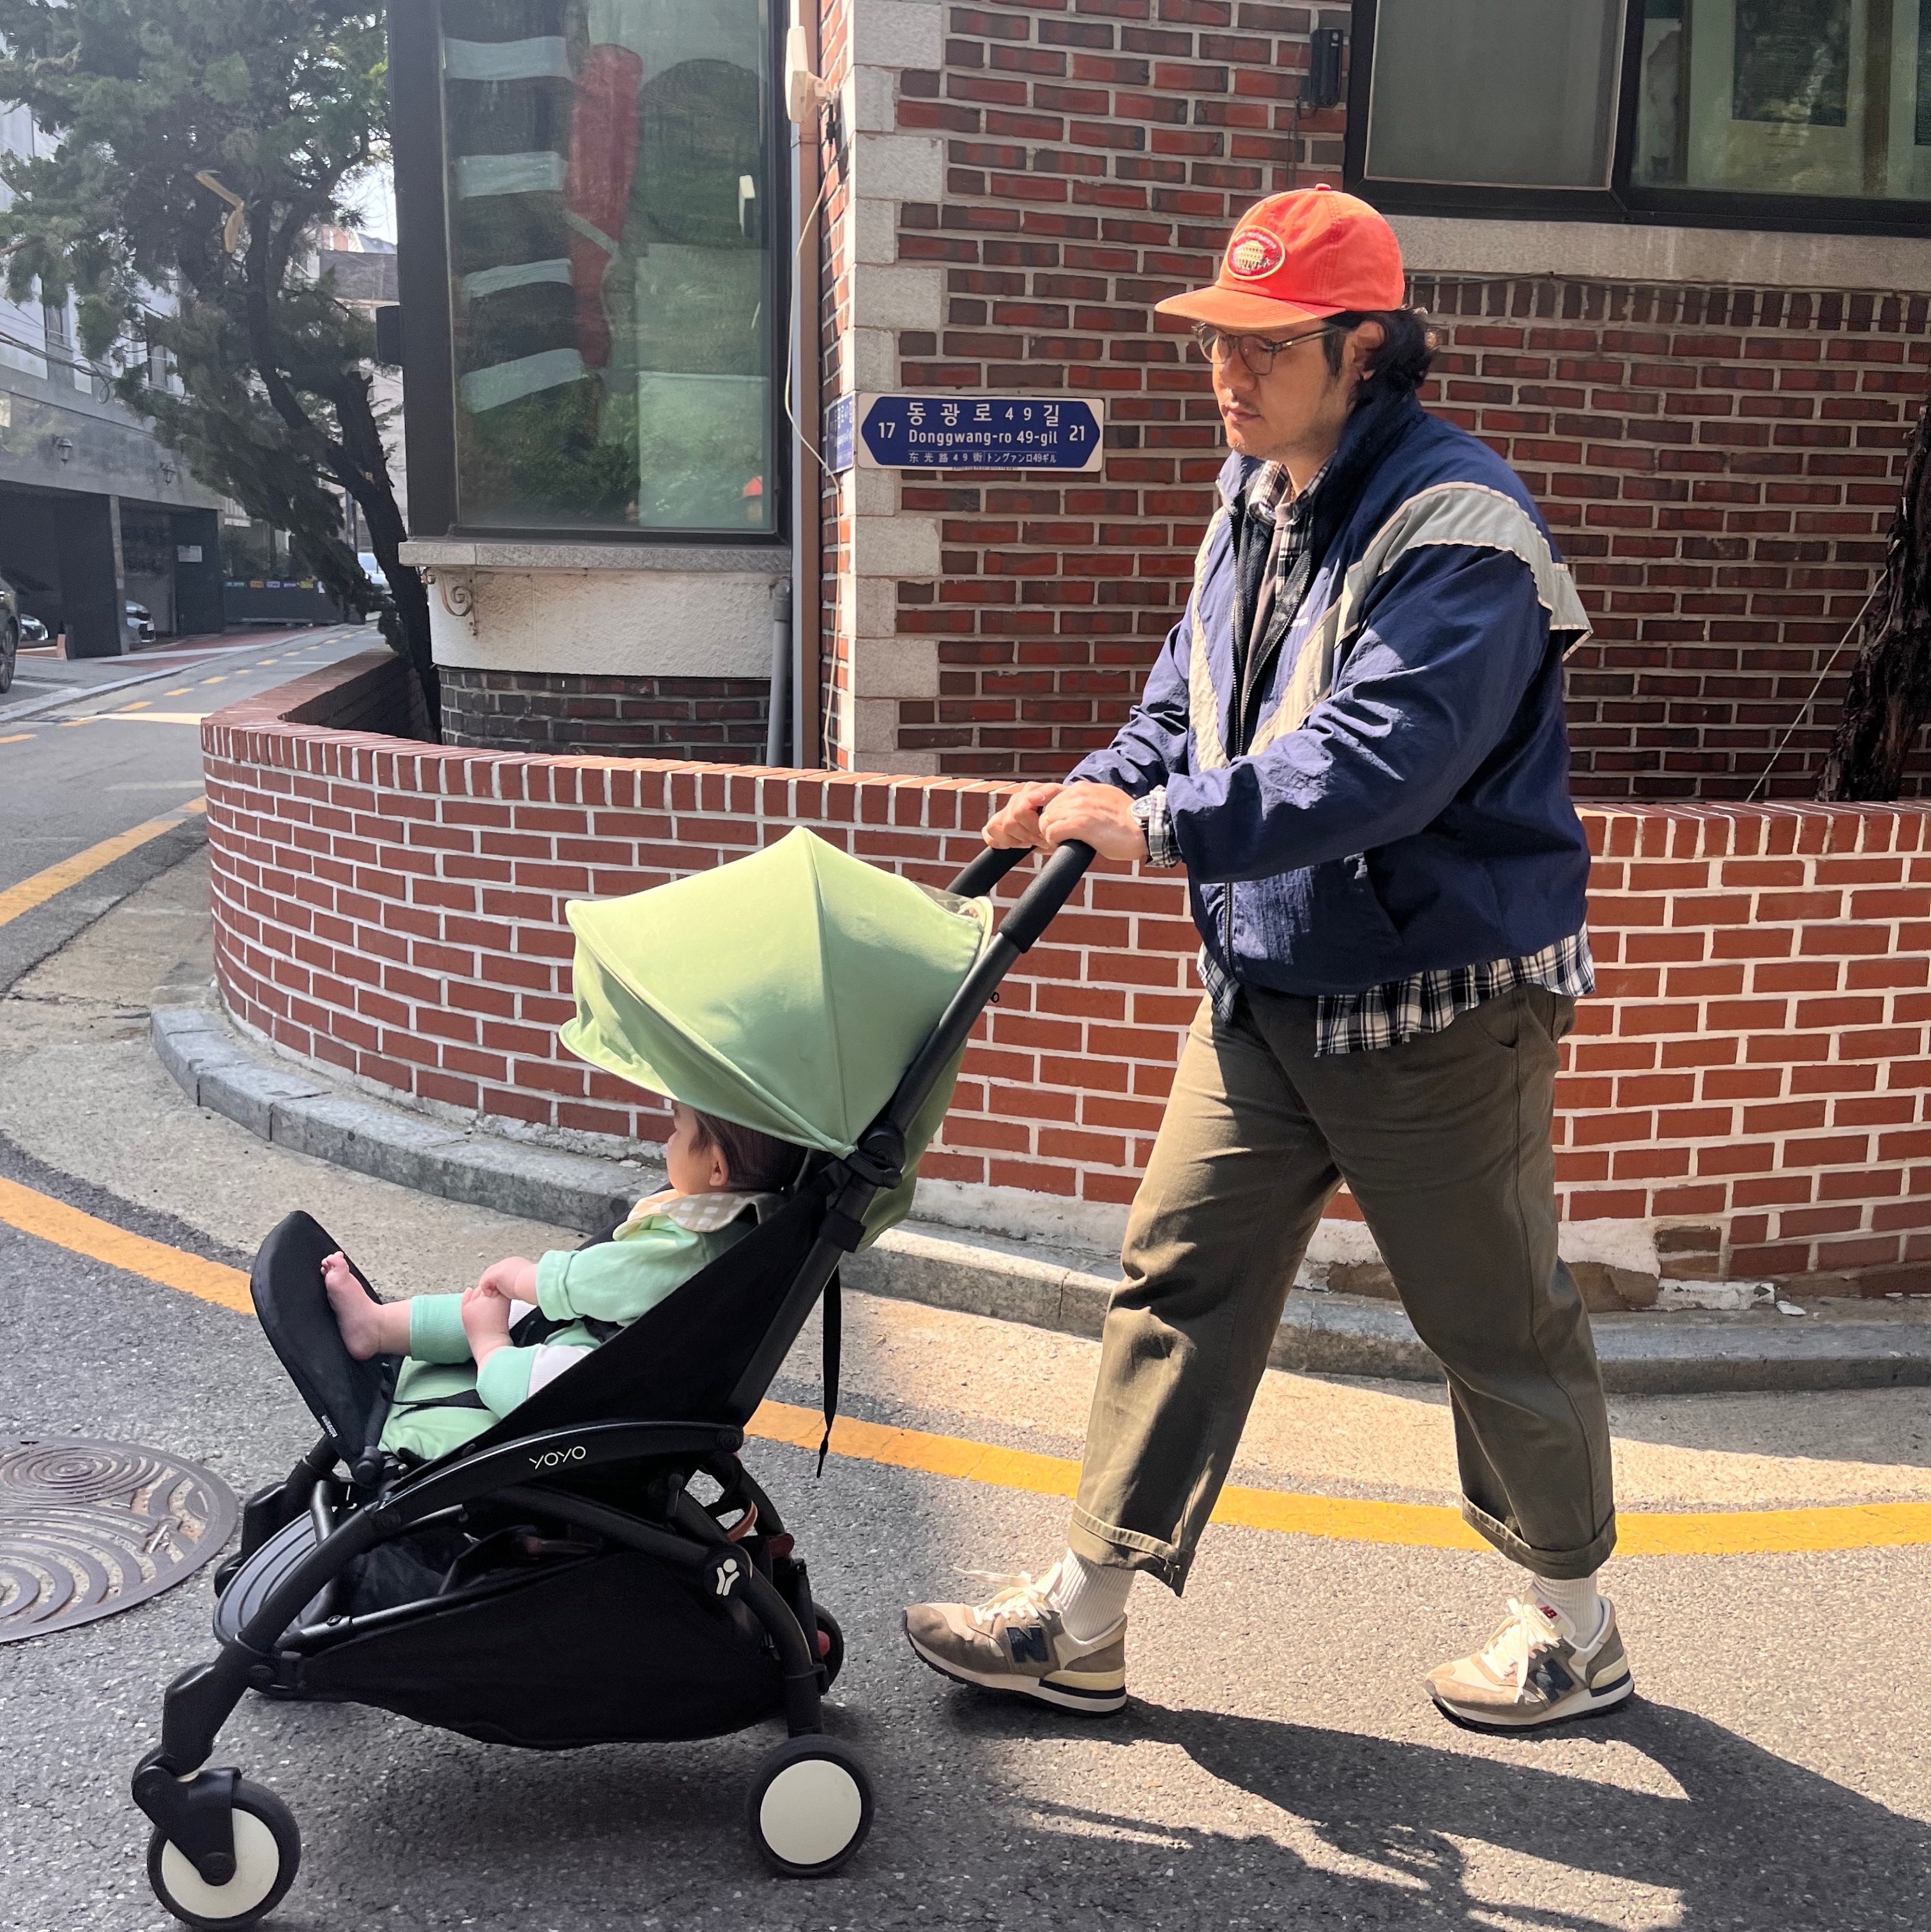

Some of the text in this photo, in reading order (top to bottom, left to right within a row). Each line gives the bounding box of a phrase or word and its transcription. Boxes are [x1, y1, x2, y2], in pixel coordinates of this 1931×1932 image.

[878, 422, 896, 439] 17
[908, 429, 1058, 447] Donggwang-ro 49-gil
[1069, 425, 1085, 441] 21
[528, 1446, 586, 1470] YOYO
